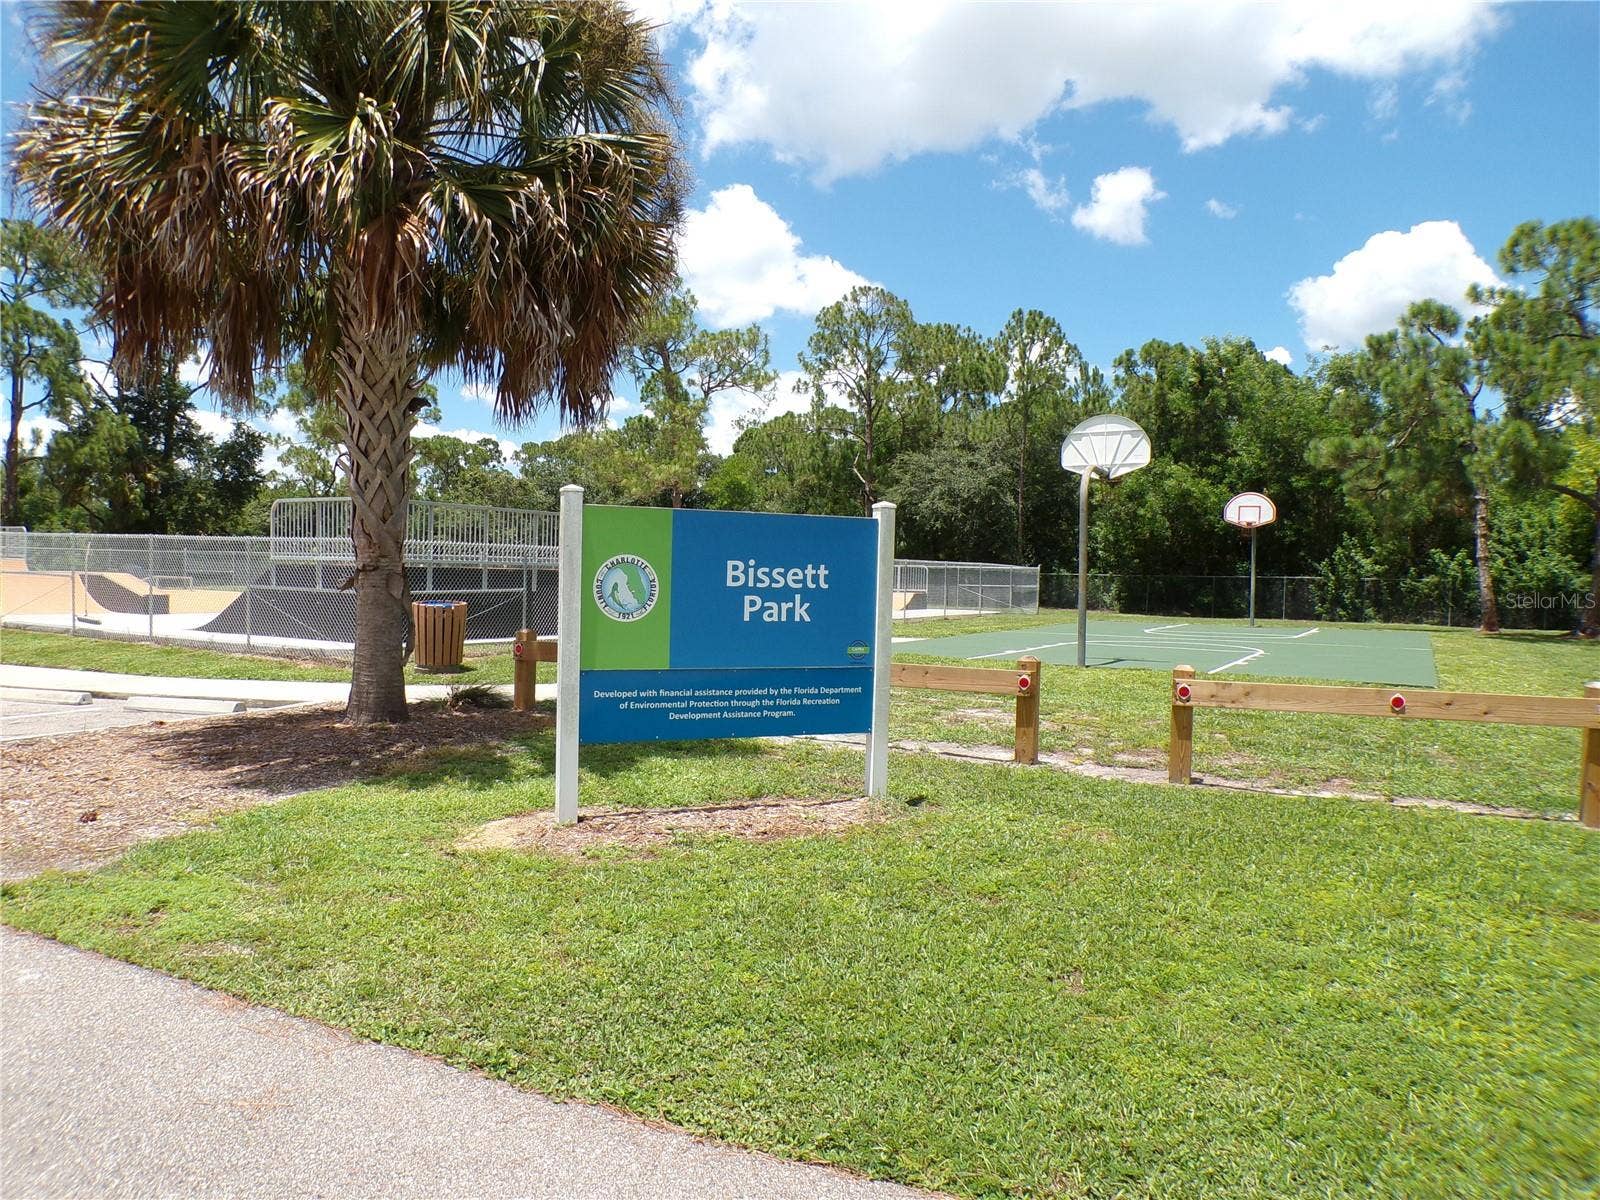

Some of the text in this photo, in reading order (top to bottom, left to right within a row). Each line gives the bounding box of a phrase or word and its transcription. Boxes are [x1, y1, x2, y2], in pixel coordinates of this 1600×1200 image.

[605, 556, 650, 570] CHARLOTTE
[726, 559, 829, 589] Bissett
[595, 578, 609, 609] COUNTY
[643, 577, 657, 612] FLORIDA
[743, 594, 811, 622] Park
[593, 686, 862, 699] Developed with financial assistance provided by the Florida Department
[619, 697, 840, 709] of Environmental Protection through the Florida Recreation
[669, 709, 796, 720] Development Assistance Program.
